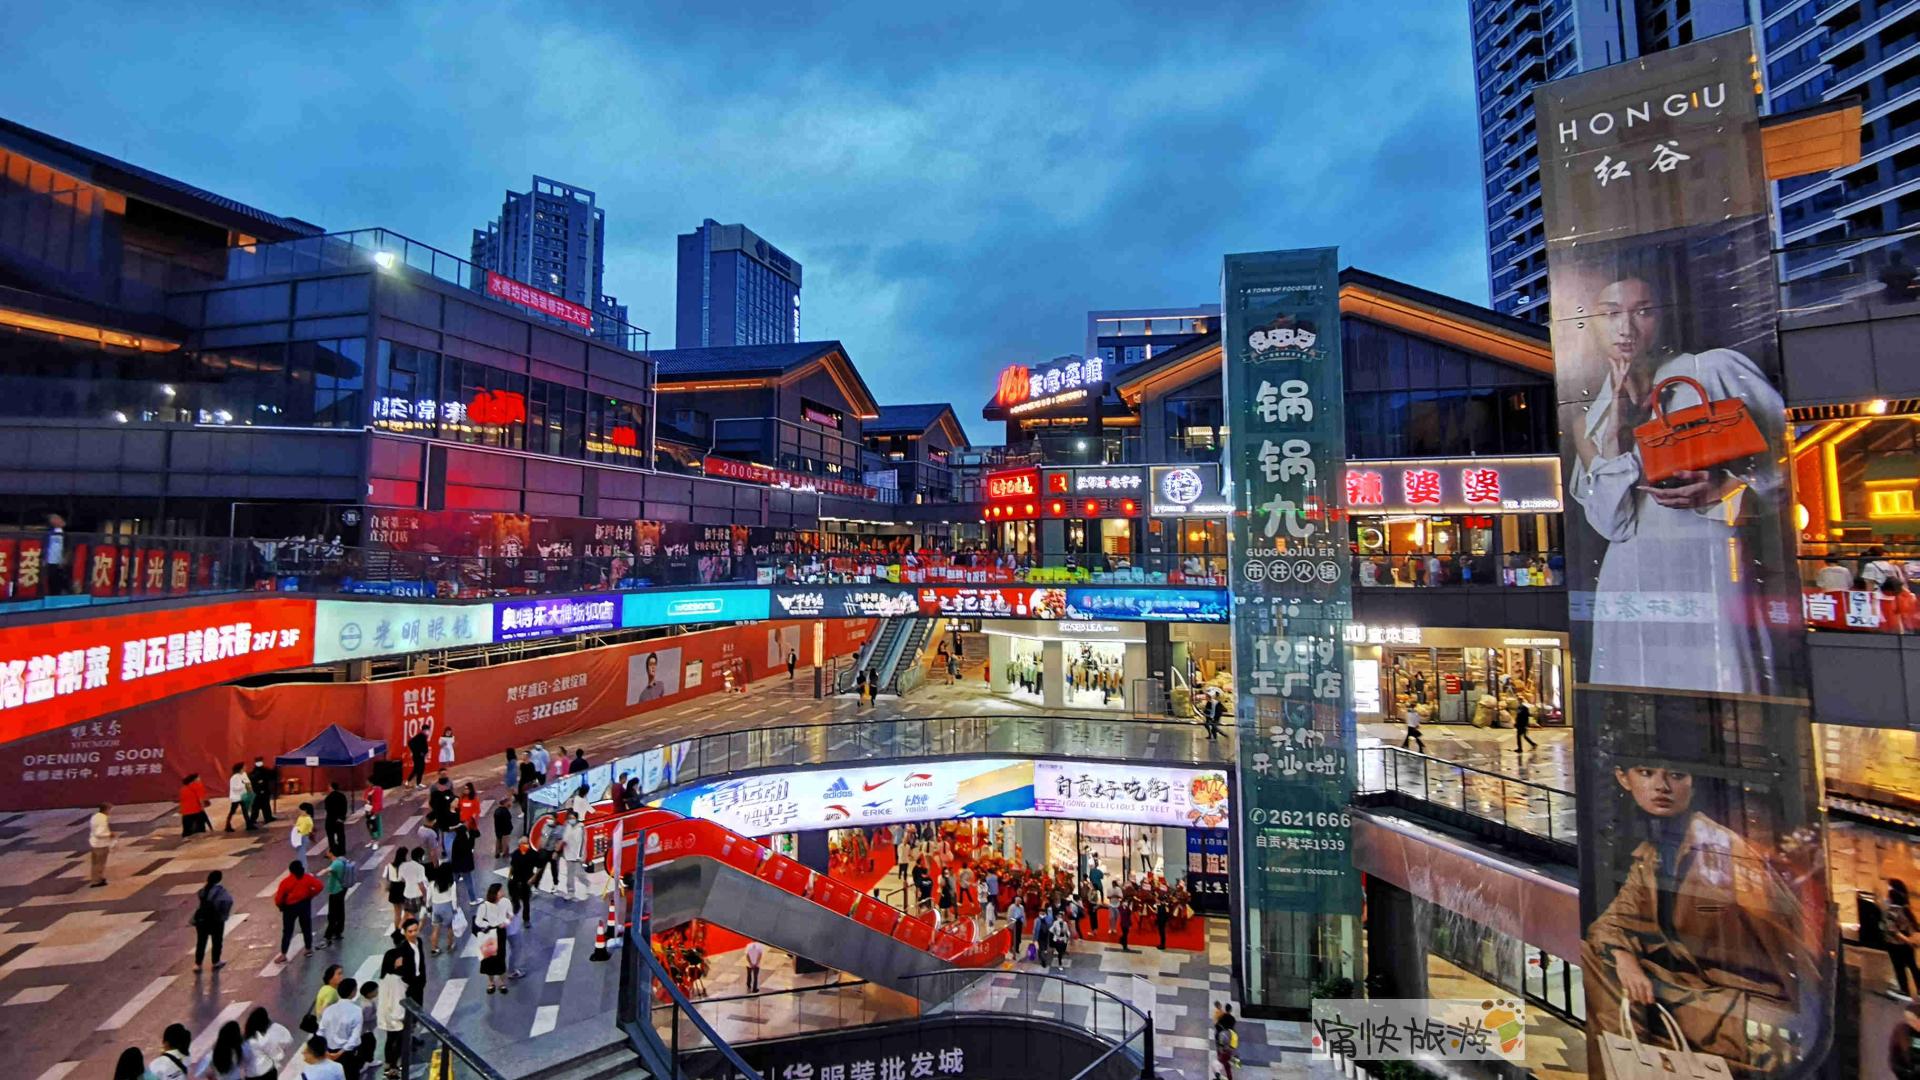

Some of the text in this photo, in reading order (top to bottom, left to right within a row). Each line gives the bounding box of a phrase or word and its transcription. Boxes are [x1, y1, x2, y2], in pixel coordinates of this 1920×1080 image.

[1593, 140, 1691, 187] 红谷
[1245, 561, 1340, 582] 市井火锅
[501, 600, 614, 631] 奥特乐大牌折扣店
[373, 614, 473, 650] 光明眼镜
[1250, 670, 1342, 698] 工厂店
[23, 748, 164, 767] OPENING SOON
[823, 788, 853, 800] adidas
[1056, 774, 1170, 803] 自贡好吃街
[862, 807, 893, 817] ERKE
[1090, 800, 1136, 812] DELICIOUS
[1140, 803, 1170, 814] STREET
[1269, 809, 1352, 828] 2621666
